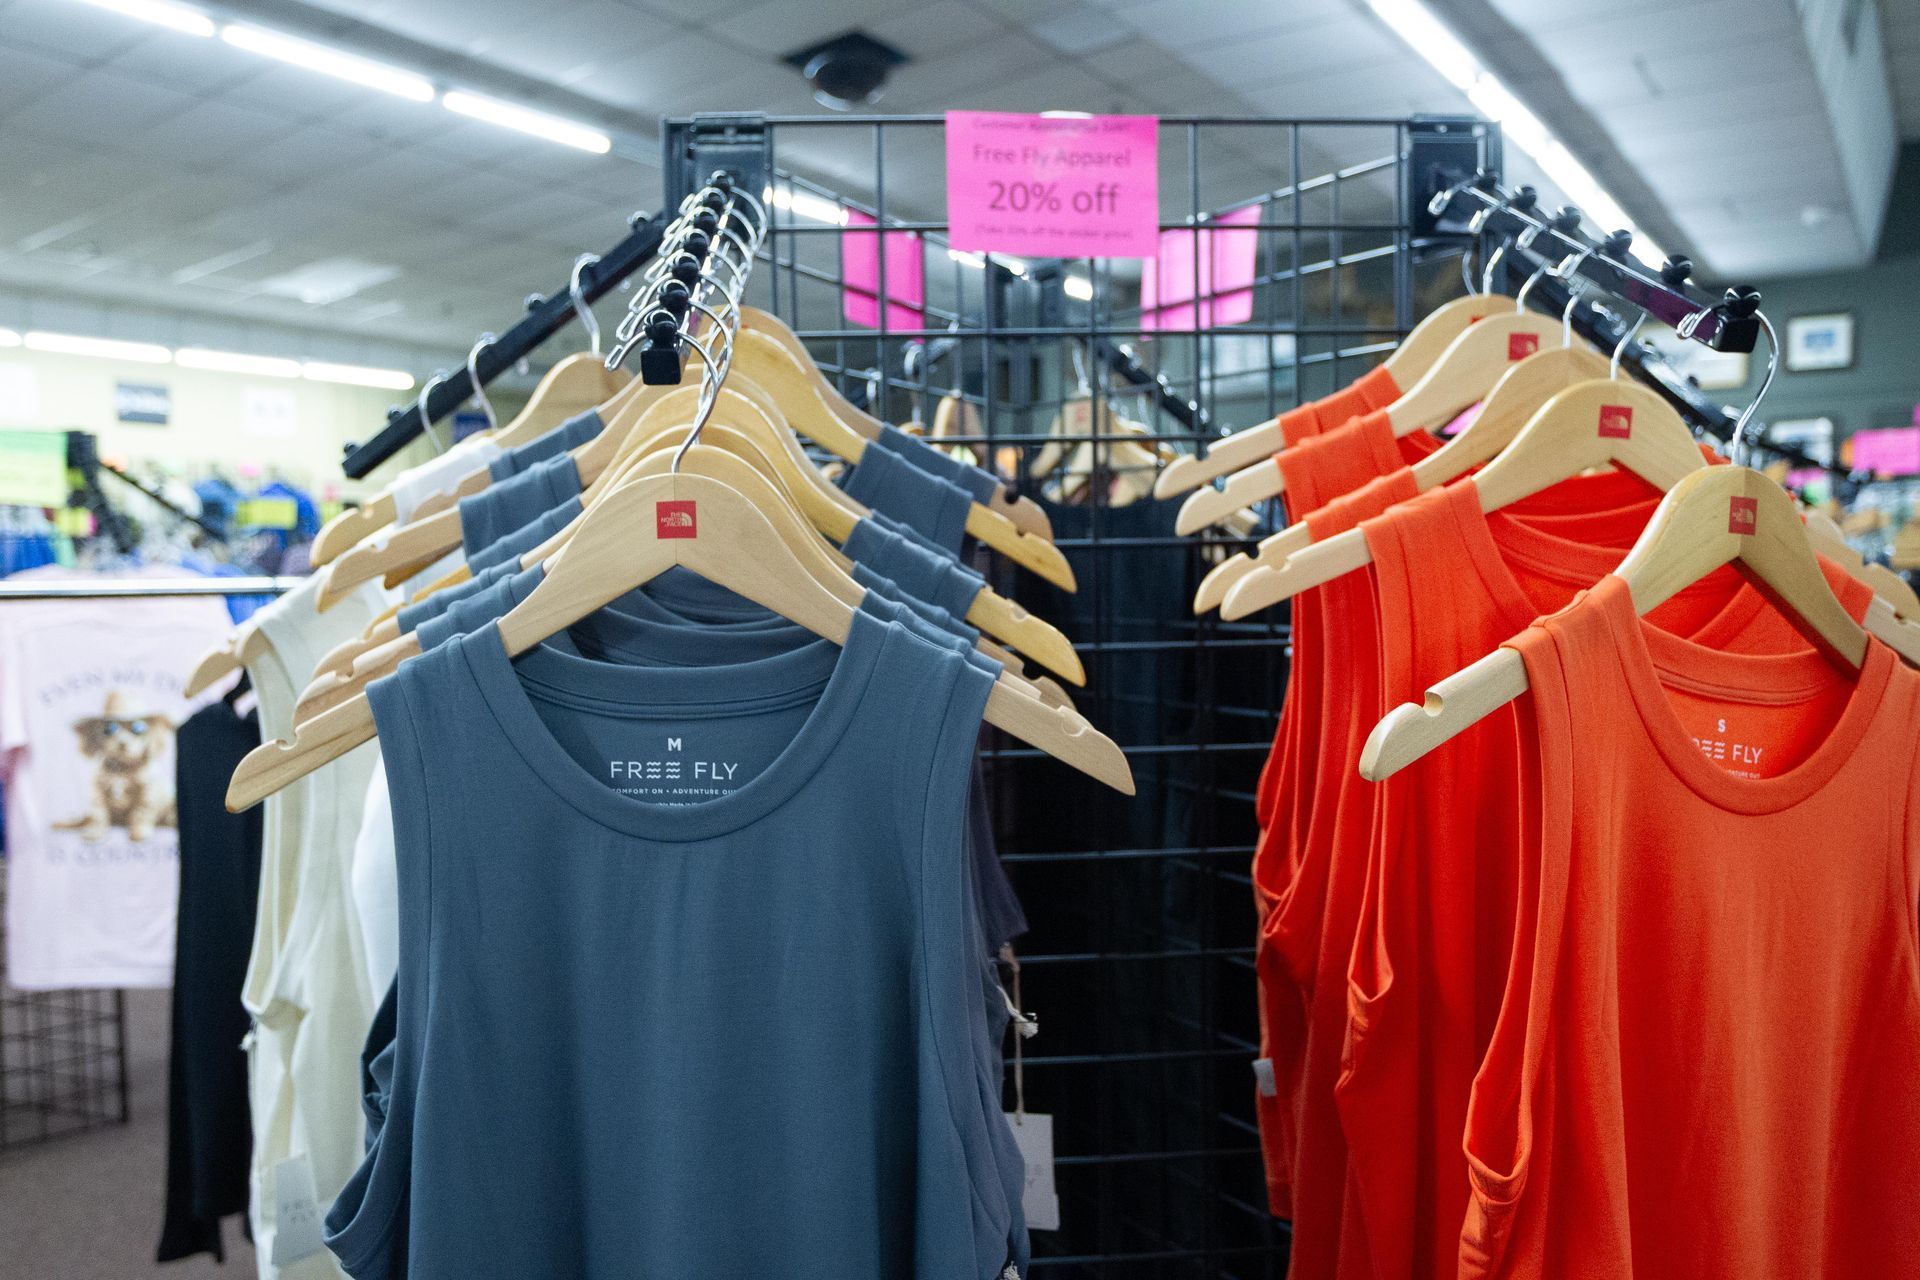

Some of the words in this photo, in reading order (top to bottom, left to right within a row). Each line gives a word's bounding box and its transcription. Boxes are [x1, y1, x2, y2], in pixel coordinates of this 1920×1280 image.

[973, 144, 1016, 164] Free
[1053, 148, 1132, 168] Apparel
[987, 180, 1062, 213] 20%
[1072, 182, 1122, 214] off
[1717, 719, 1726, 733] S
[667, 737, 682, 752] M
[1732, 743, 1763, 764] FLY
[610, 761, 681, 779] FREE
[694, 761, 738, 780] FLY
[672, 788, 719, 796] ADVENTURE
